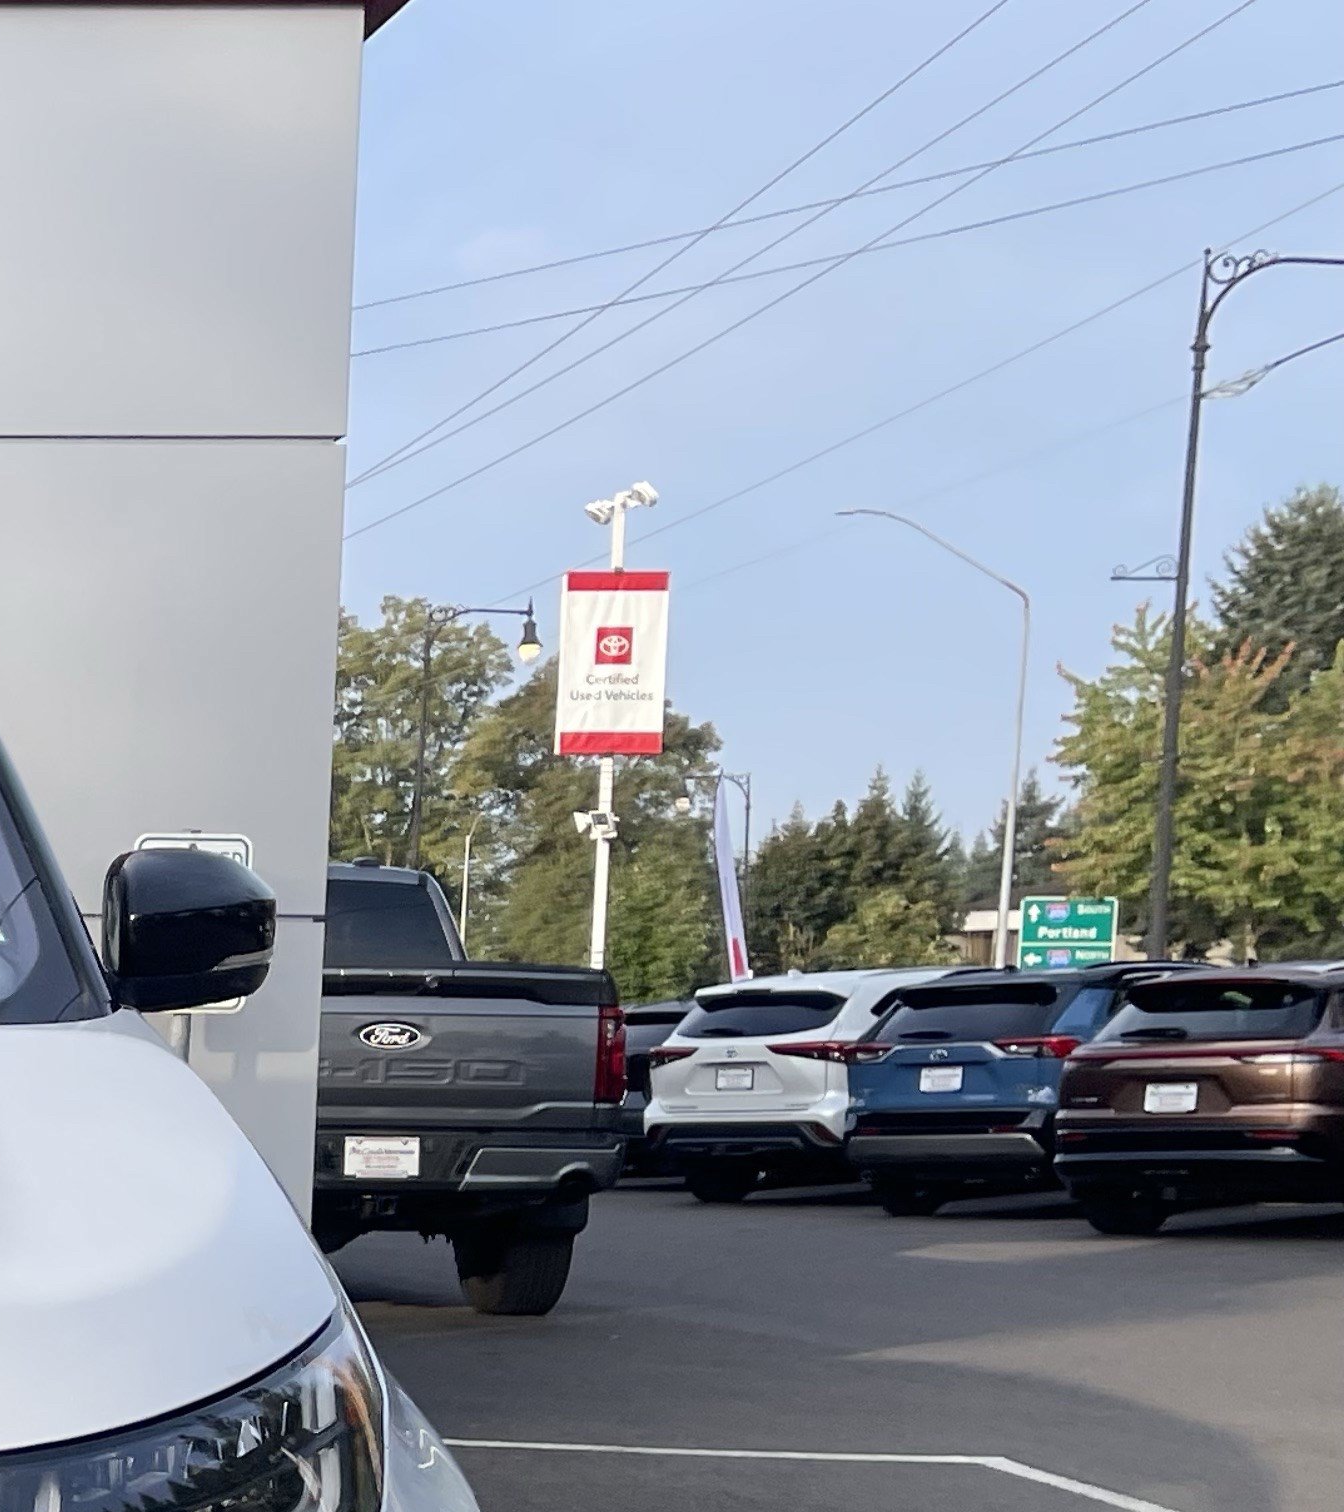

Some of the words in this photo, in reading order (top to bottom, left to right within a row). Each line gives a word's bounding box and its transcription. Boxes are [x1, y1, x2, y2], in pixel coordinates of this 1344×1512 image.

[585, 673, 640, 685] Certified
[569, 690, 602, 701] Used
[605, 690, 654, 701] Vehicles
[1037, 925, 1097, 939] Portland
[369, 1027, 410, 1045] Ford
